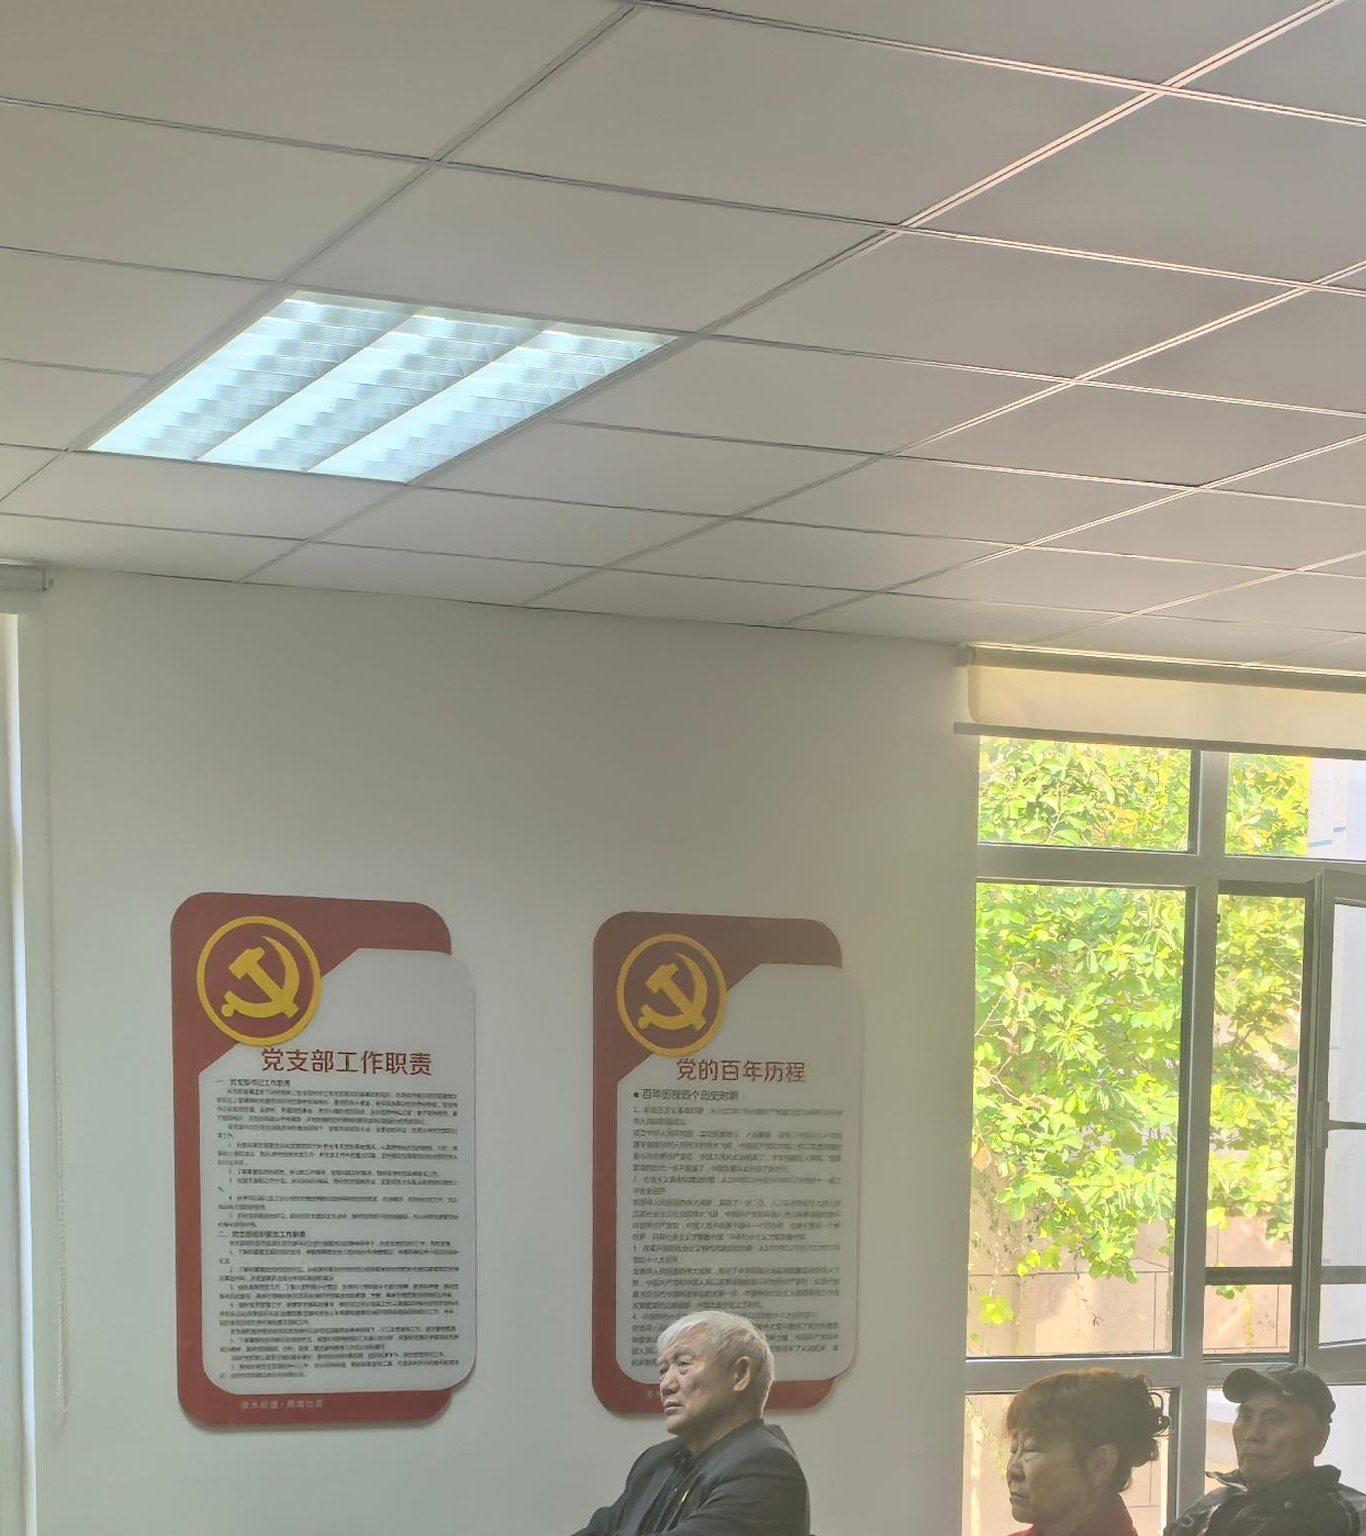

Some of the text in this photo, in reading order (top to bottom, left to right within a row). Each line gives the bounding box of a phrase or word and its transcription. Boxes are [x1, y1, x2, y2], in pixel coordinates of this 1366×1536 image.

[261, 1047, 433, 1076] 党支部工作职责
[676, 1057, 807, 1083] 党的百年历程
